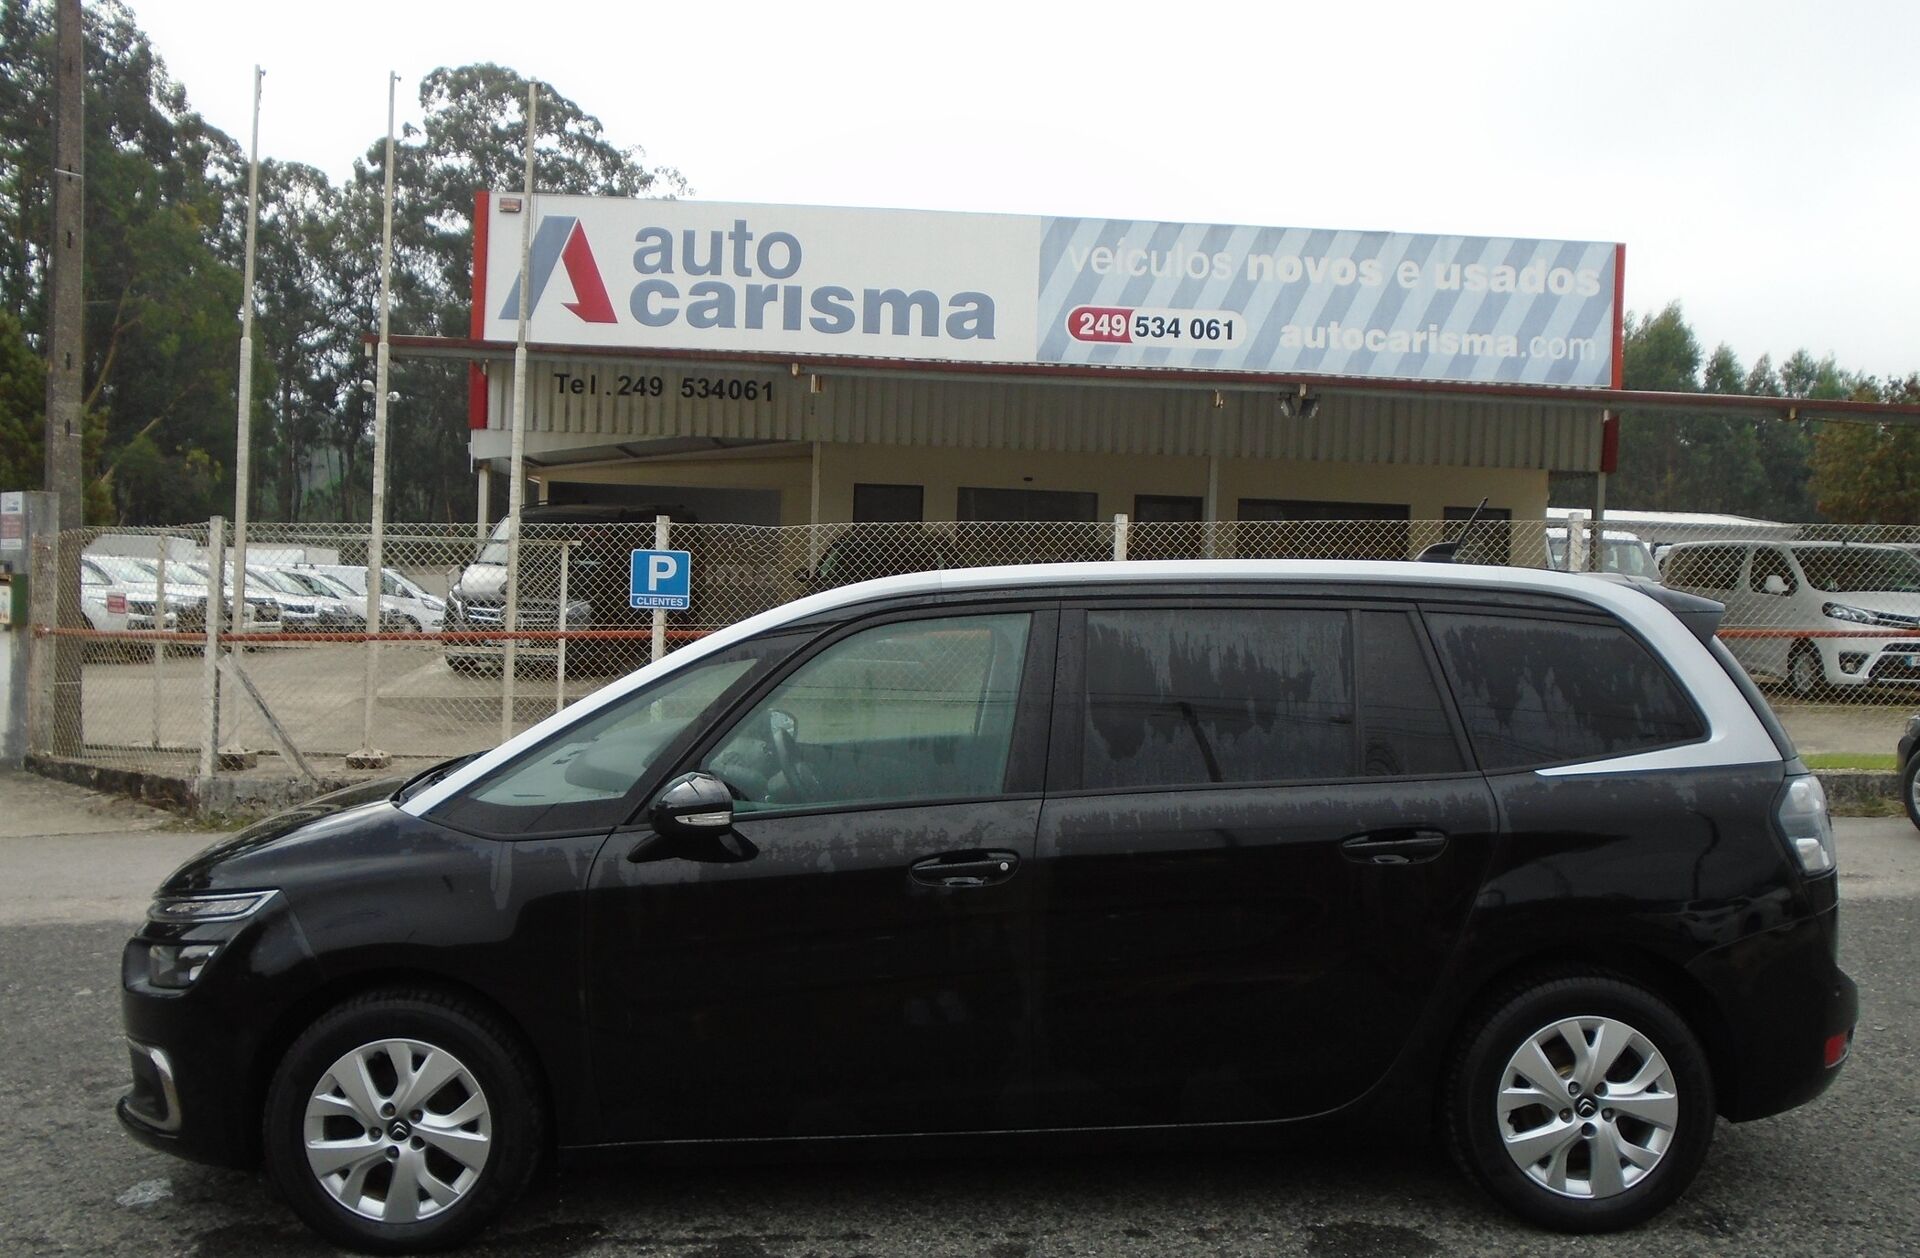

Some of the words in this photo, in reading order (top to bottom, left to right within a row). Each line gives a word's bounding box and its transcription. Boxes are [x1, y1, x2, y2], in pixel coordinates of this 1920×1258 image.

[633, 219, 802, 279] auto
[1068, 236, 1233, 280] veículos
[1247, 252, 1383, 288] novos
[1396, 259, 1420, 289] e
[1434, 258, 1601, 297] usados
[630, 278, 995, 340] carisma
[1079, 312, 1127, 337] 249
[1134, 316, 1181, 338] 534
[1189, 318, 1234, 340] 061
[1280, 321, 1597, 361] autocarisma.com
[680, 376, 773, 402] 534061
[648, 555, 677, 591] P
[636, 596, 684, 607] CLIENTES
